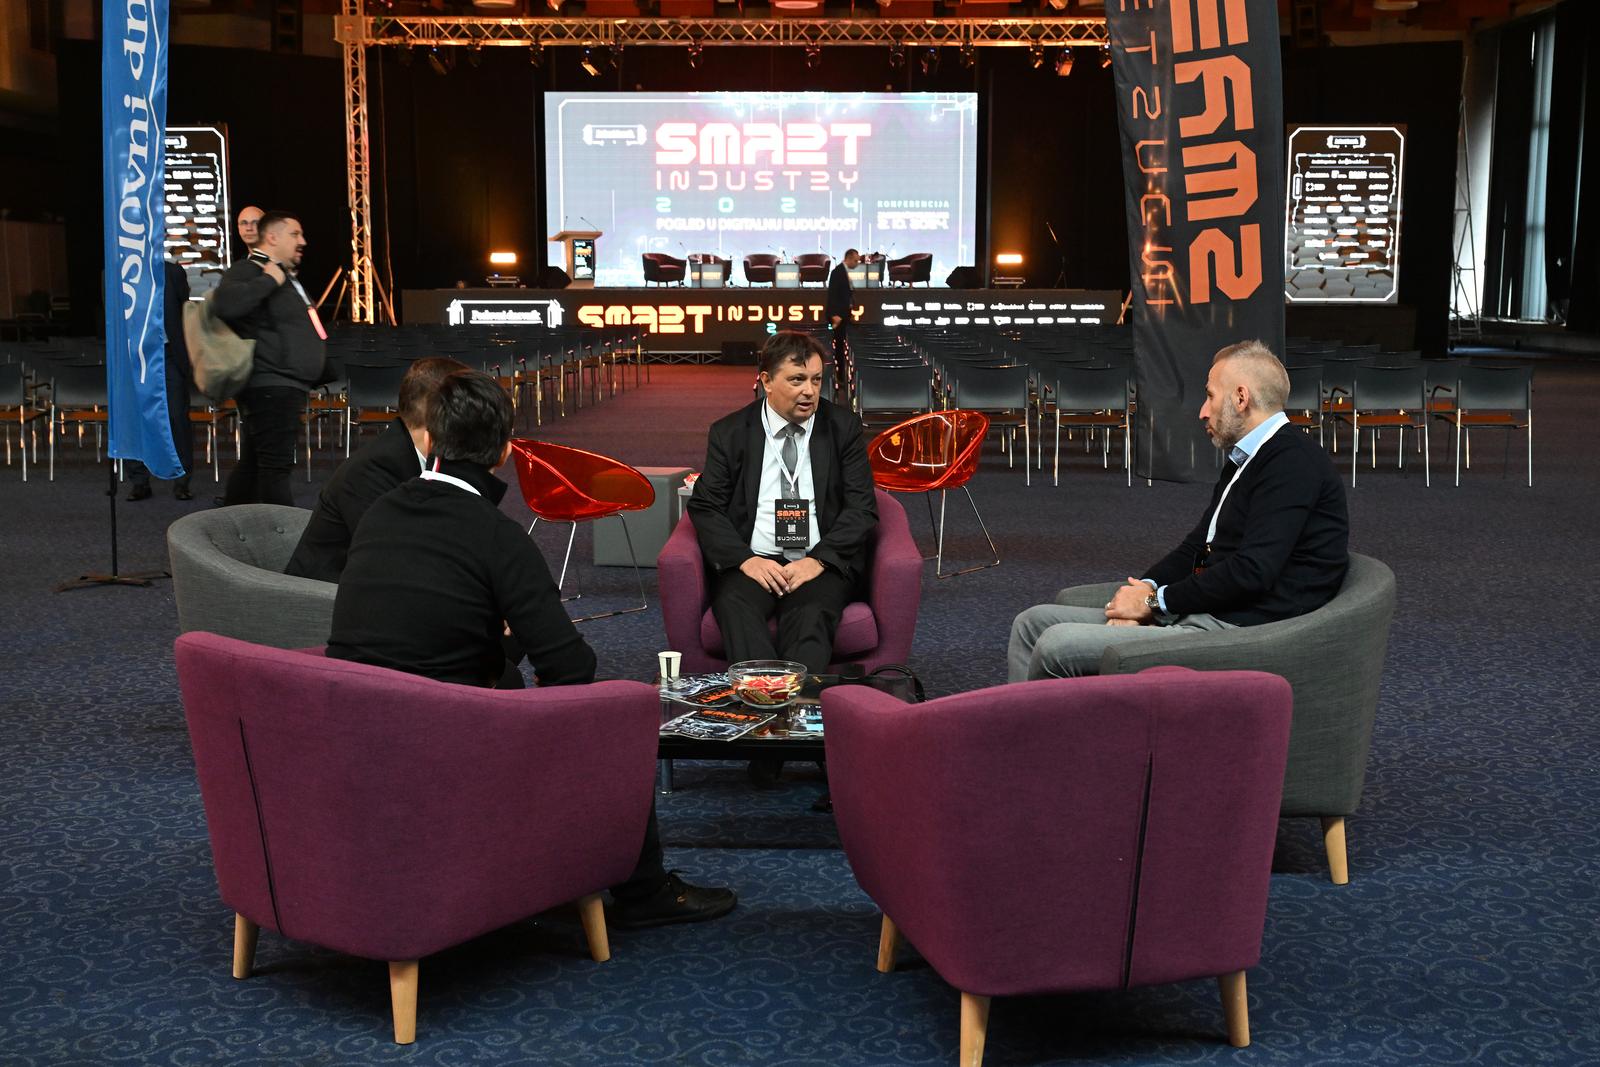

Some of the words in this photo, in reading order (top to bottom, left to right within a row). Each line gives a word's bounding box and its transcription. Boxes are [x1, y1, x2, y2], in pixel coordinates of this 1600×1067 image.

[655, 122, 871, 165] SMART
[655, 169, 859, 191] INDUSTRY
[877, 199, 950, 208] KONFERENCIJA
[656, 217, 705, 231] POGLED
[707, 217, 718, 231] U
[719, 217, 782, 231] DIGITALNU
[717, 305, 864, 322] INDUSTY
